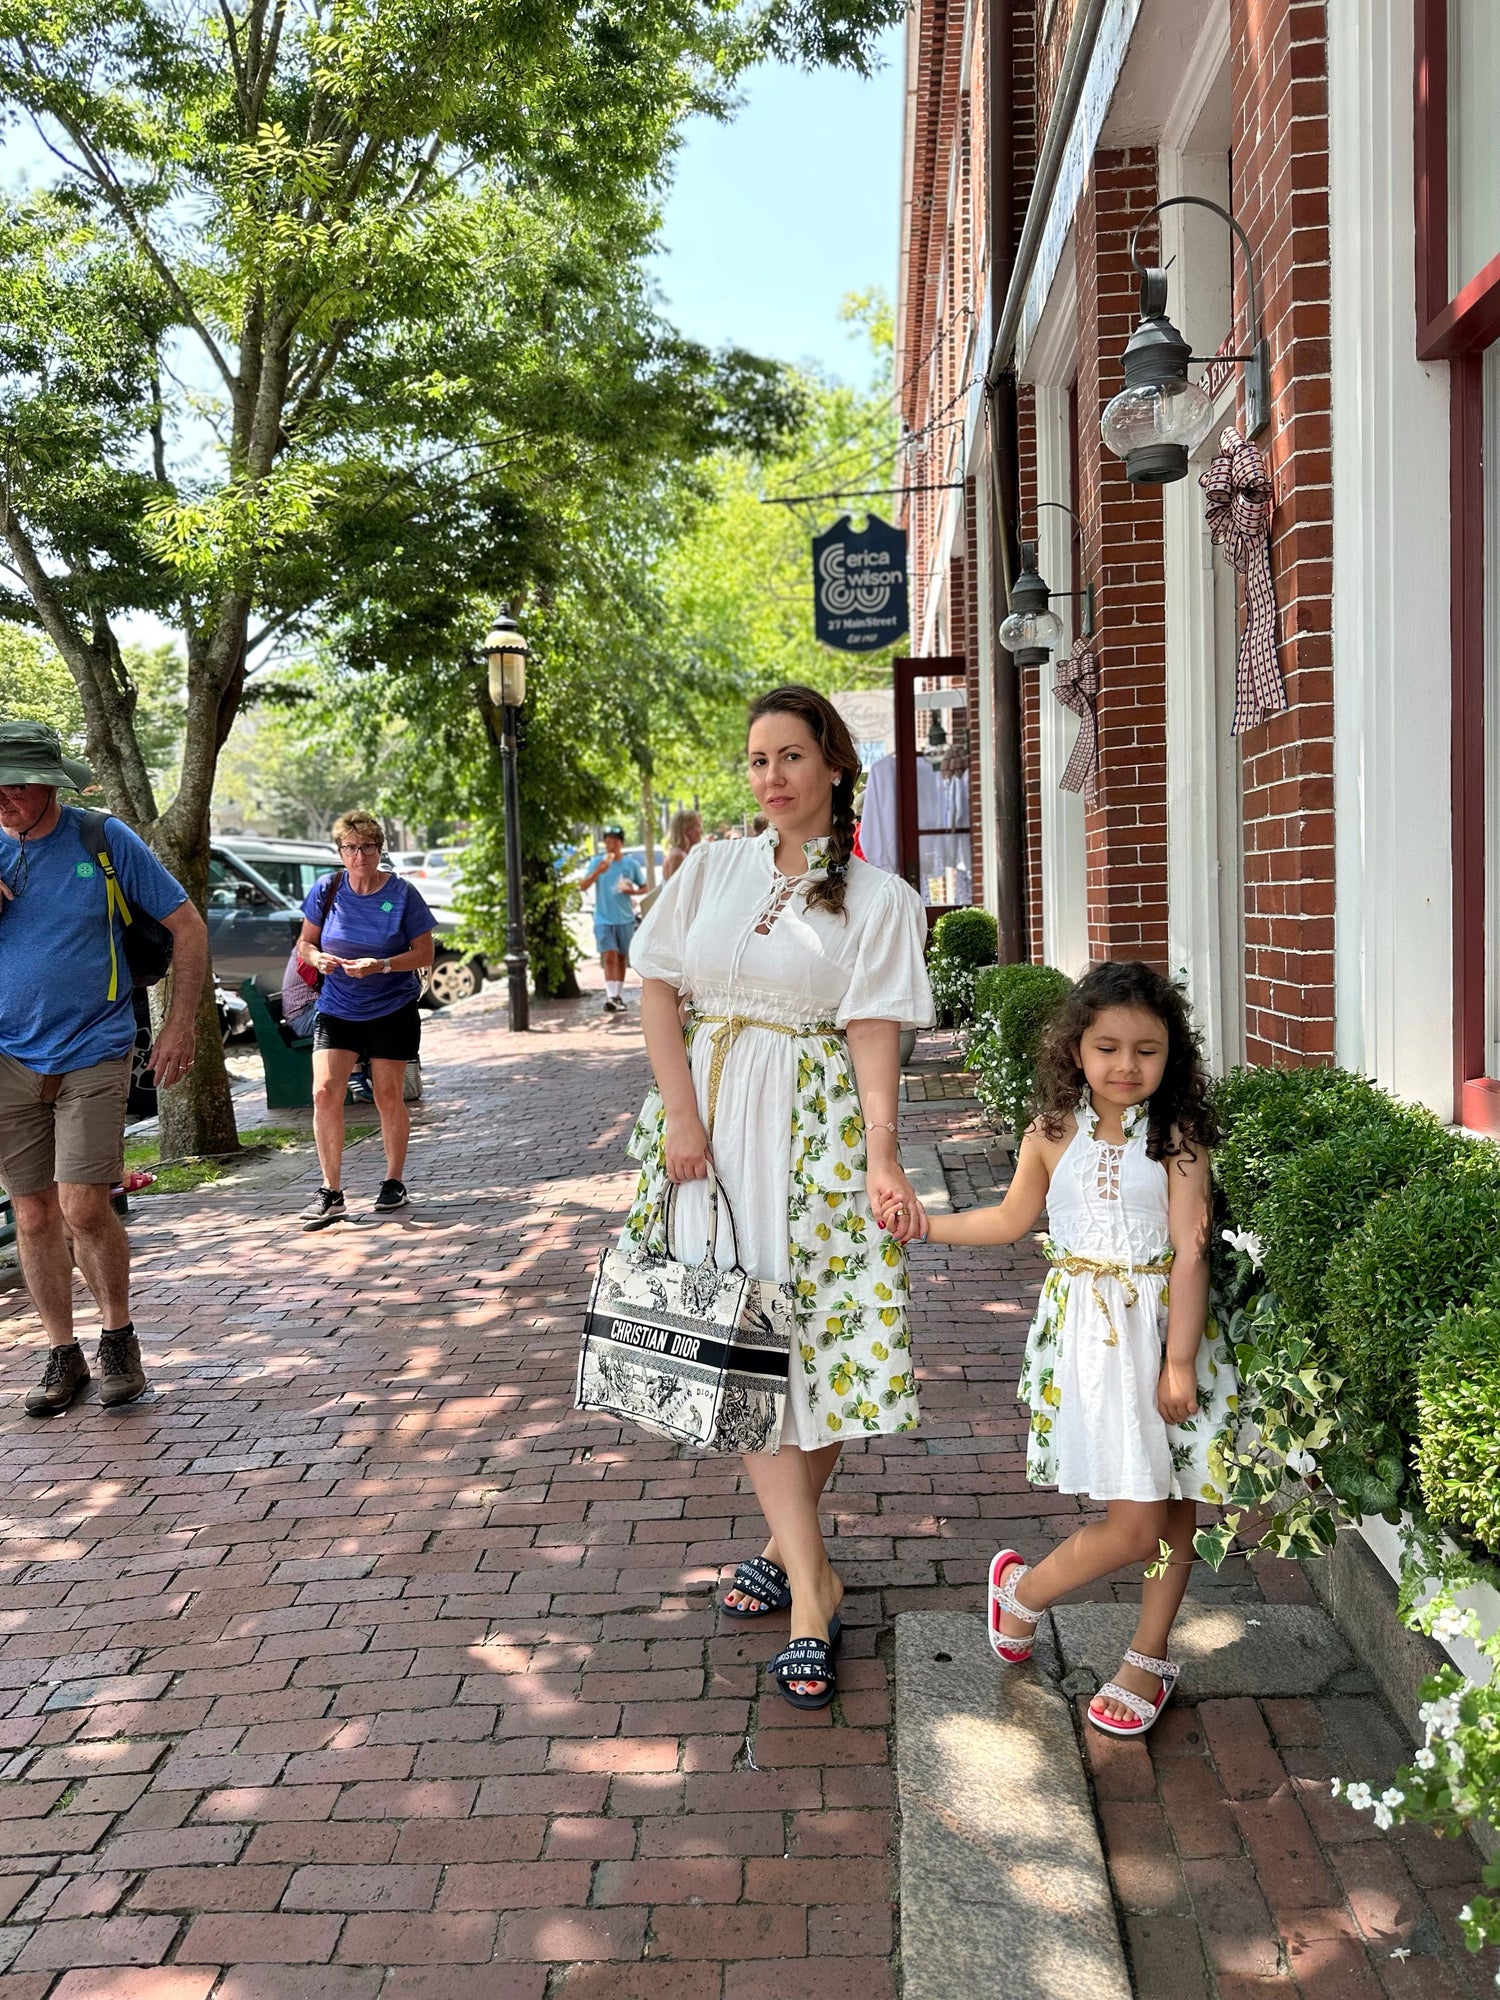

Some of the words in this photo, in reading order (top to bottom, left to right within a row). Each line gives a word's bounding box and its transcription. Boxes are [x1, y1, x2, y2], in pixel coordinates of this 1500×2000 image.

[846, 549, 891, 567] erica
[847, 569, 903, 587] wilson
[827, 619, 841, 631] 27
[610, 1319, 669, 1352] CHRISTIAN
[670, 1334, 701, 1360] DIOR
[765, 1581, 782, 1598] DIOR
[806, 1650, 826, 1660] DIOR
